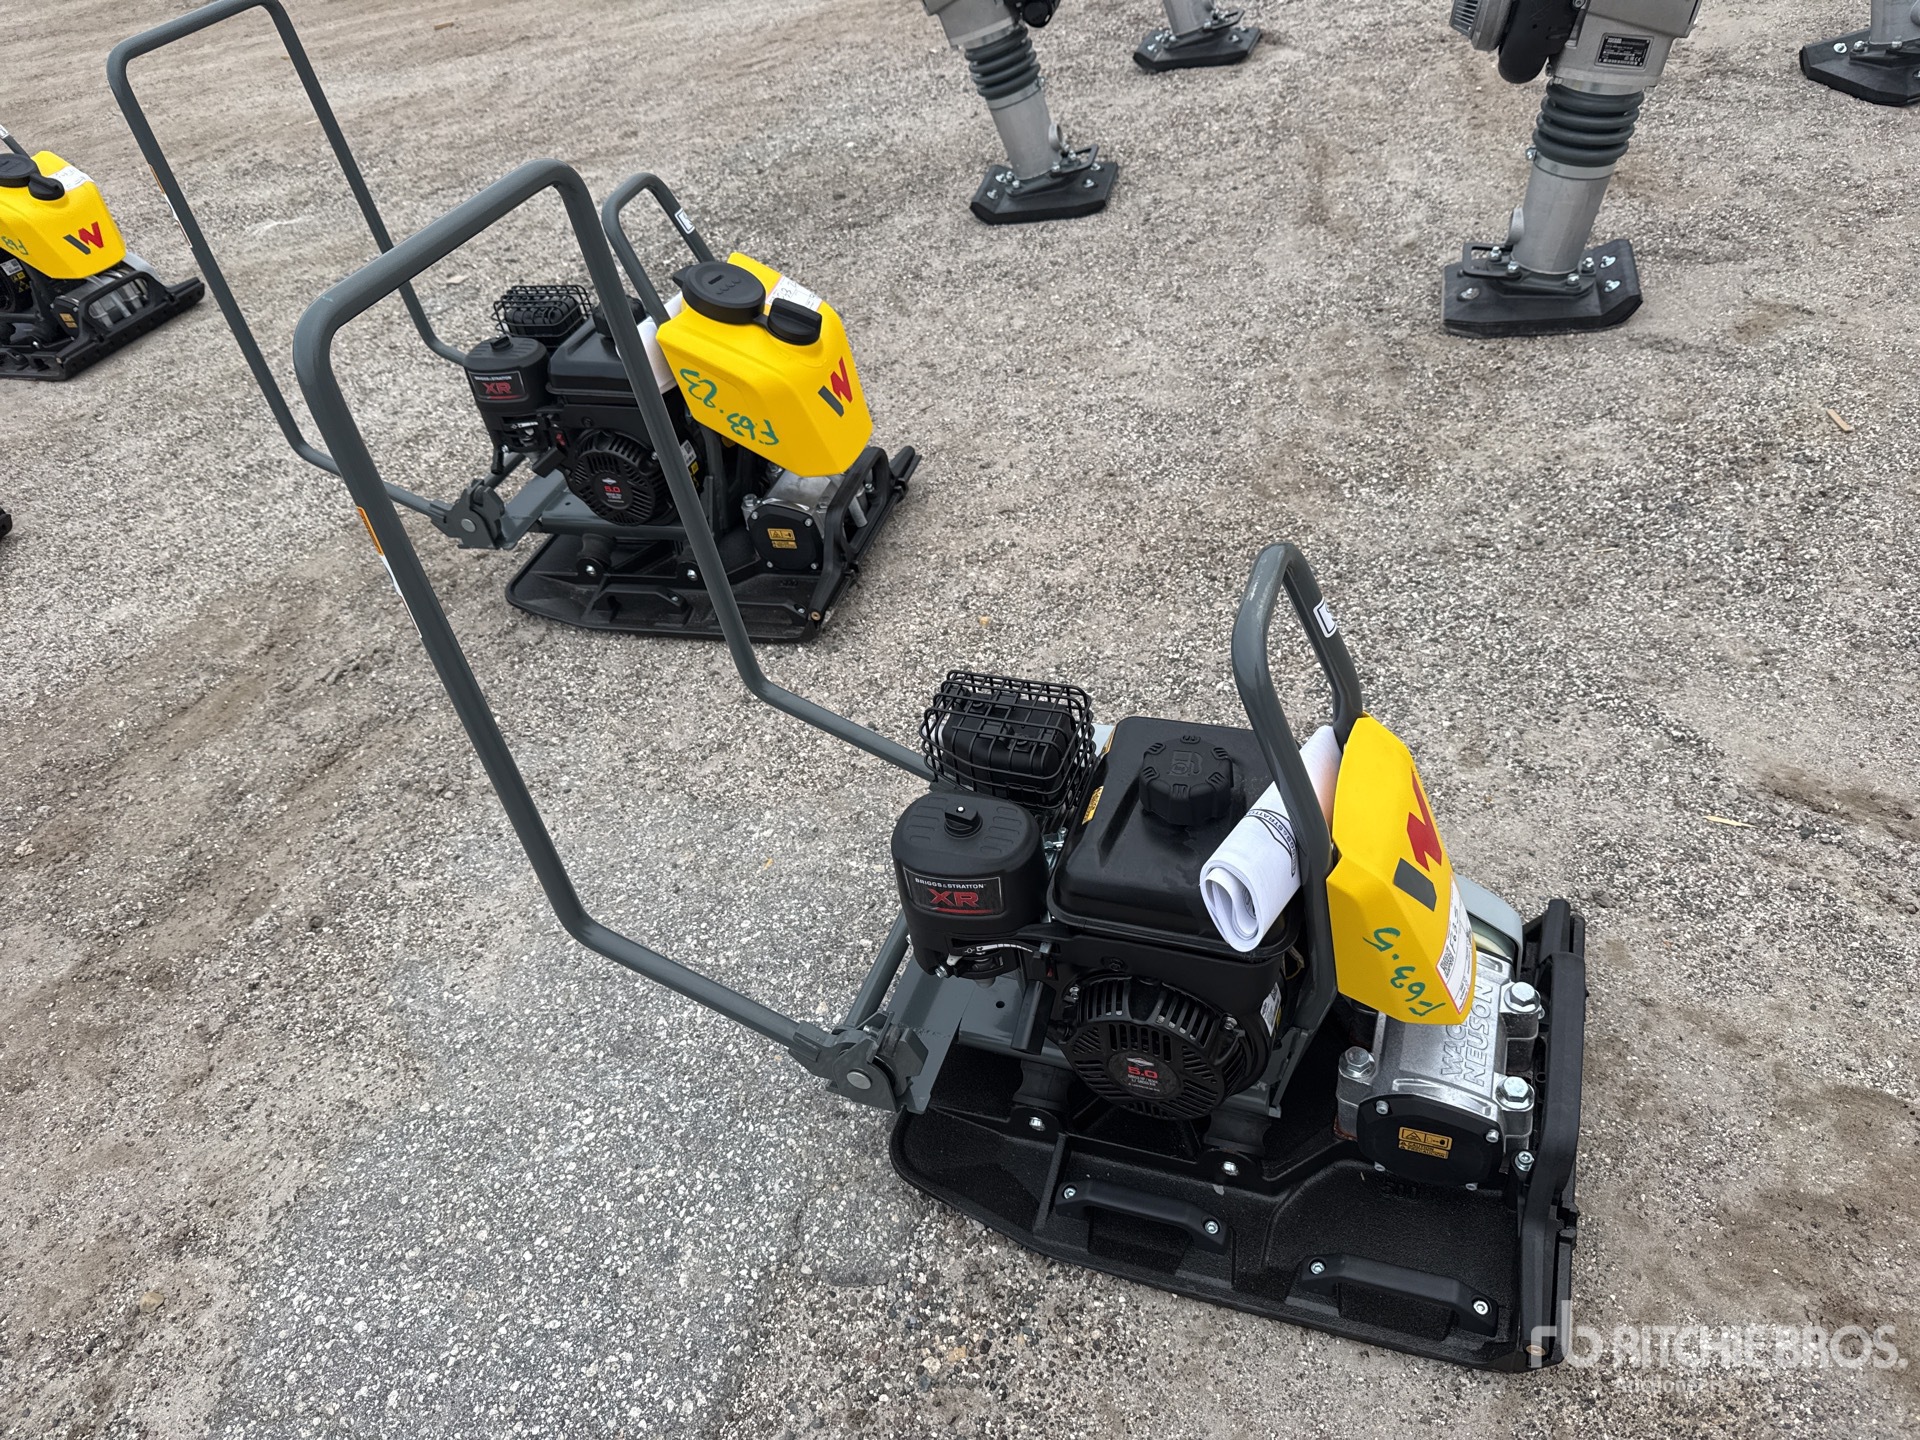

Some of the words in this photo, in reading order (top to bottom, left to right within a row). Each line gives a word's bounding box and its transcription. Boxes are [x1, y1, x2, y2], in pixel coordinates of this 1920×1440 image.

[482, 381, 512, 394] XR
[928, 887, 979, 907] XR
[1362, 927, 1446, 1016] F63.5
[1463, 983, 1493, 1087] NEUSON
[1127, 1066, 1159, 1079] 5.0
